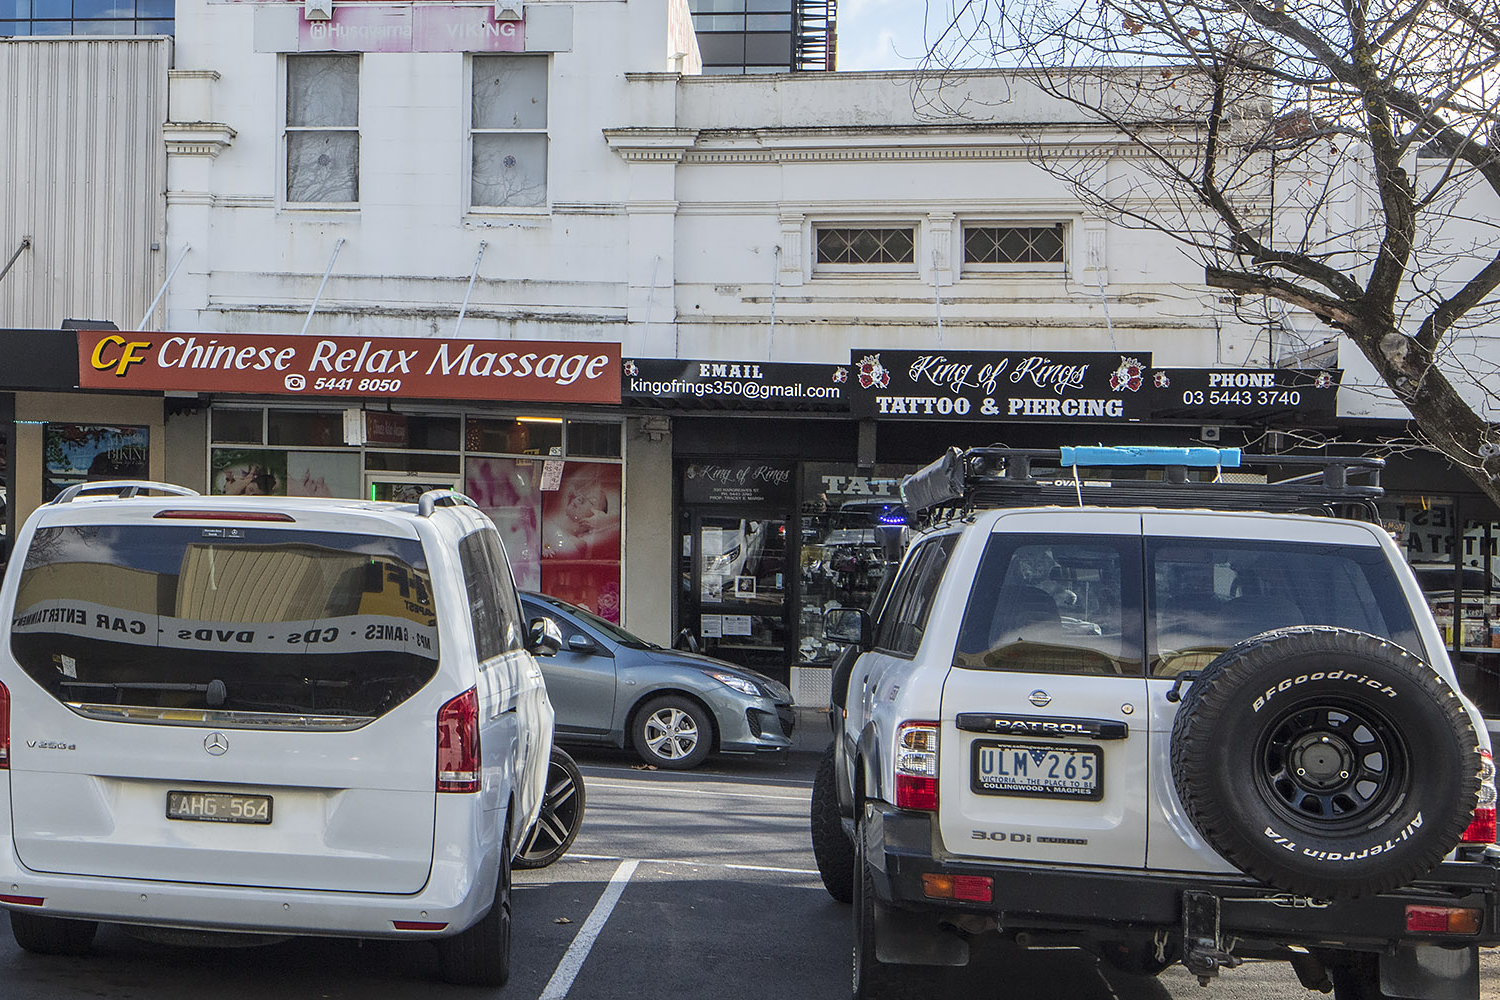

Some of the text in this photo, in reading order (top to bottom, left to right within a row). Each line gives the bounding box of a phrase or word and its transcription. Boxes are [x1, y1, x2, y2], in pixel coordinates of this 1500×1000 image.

[446, 21, 516, 38] VIKING
[91, 335, 609, 385] CF Chinese Relax Massage
[699, 363, 763, 379] EMAIL
[908, 355, 1090, 393] King of Rings
[314, 378, 401, 393] 5441 8050
[630, 378, 841, 399] kingofrings350@gmail.com
[1208, 372, 1276, 389] PHONE
[876, 396, 1124, 417] TATTOO & PIERCING
[1182, 390, 1301, 406] 03 5443 3740
[702, 465, 731, 482] King
[752, 465, 790, 485] Rings
[822, 475, 907, 495] TAT
[1252, 670, 1398, 713] BFGoodrich
[995, 719, 1092, 734] PATROL
[981, 750, 1093, 780] ULM 265
[982, 776, 1016, 784] VICTORIA
[983, 783, 1044, 792] COLLINGWOOD
[178, 796, 268, 819] AHG 564
[972, 830, 1032, 843] 3.0 Di
